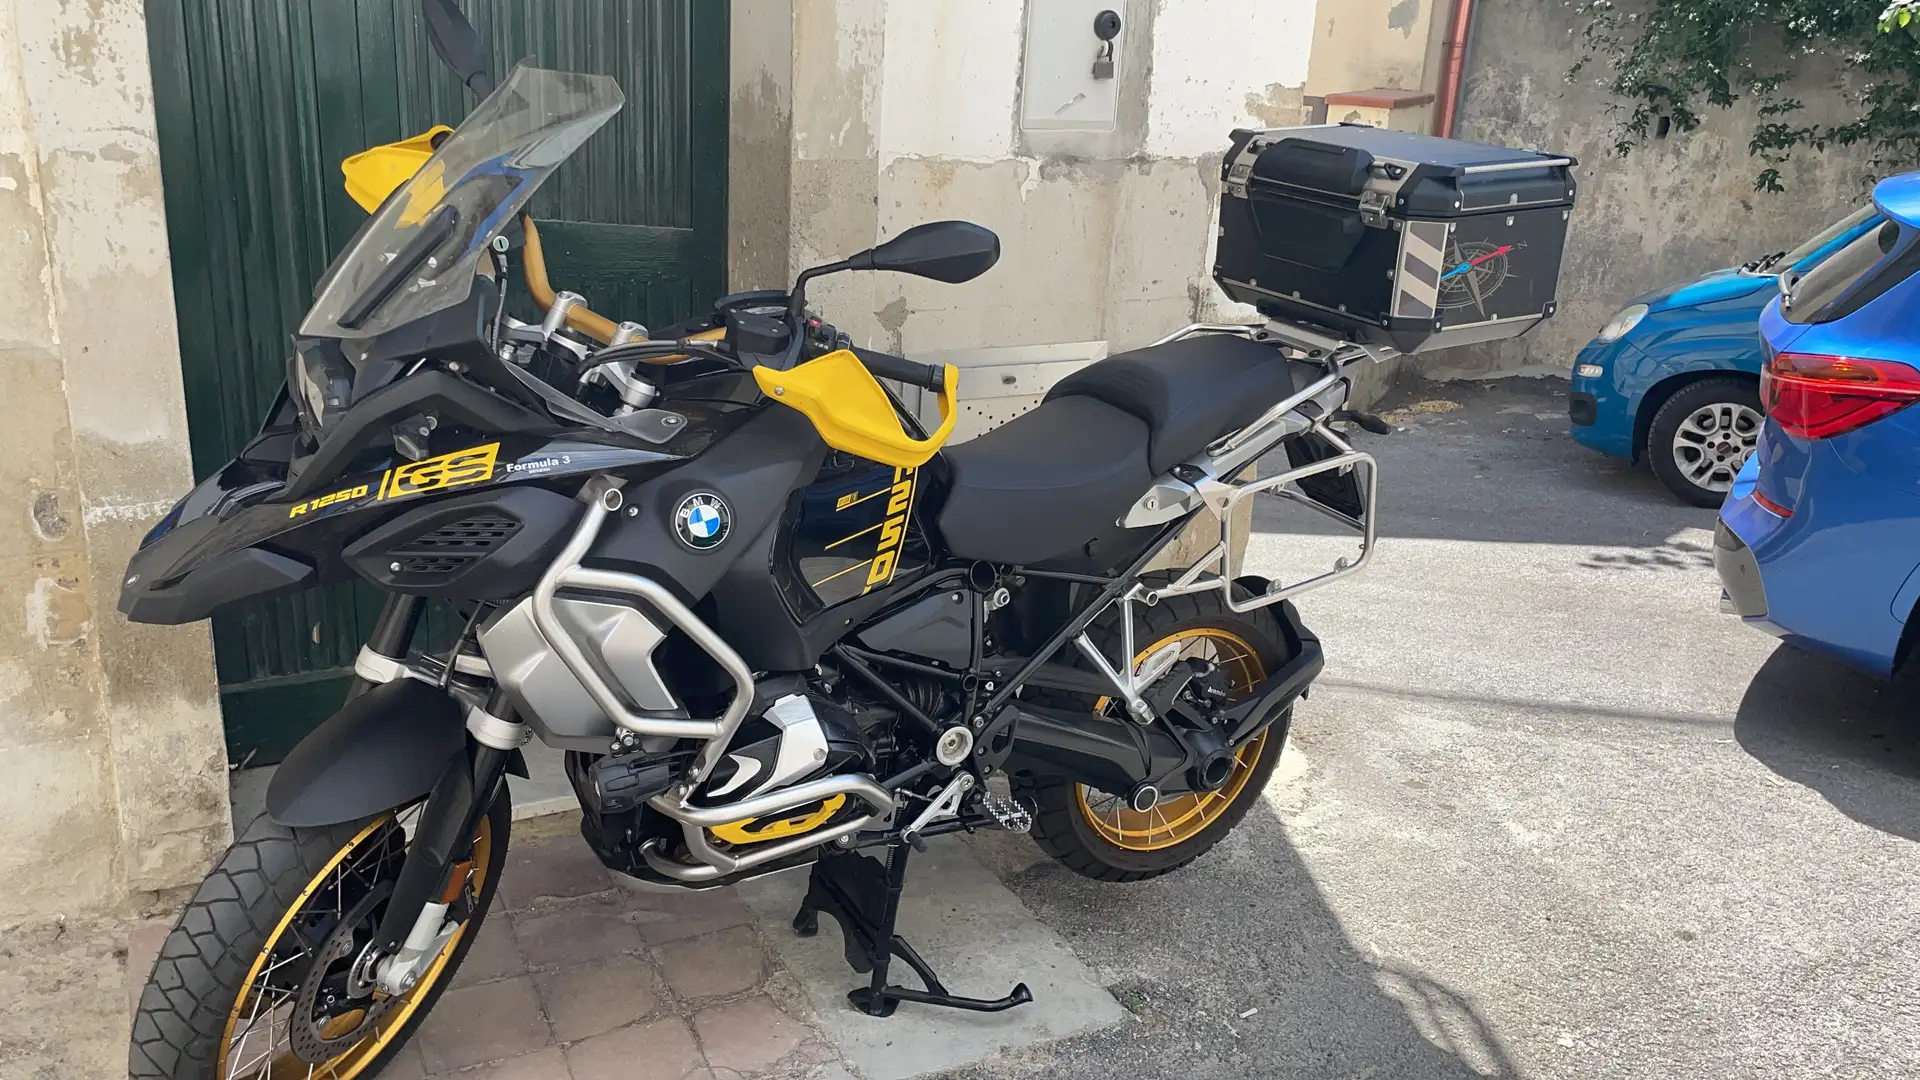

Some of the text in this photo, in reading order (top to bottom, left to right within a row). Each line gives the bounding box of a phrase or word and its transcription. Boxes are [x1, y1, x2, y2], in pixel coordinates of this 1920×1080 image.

[506, 457, 560, 473] Formula
[562, 455, 571, 465] 3
[288, 451, 493, 519] R 1250 GS
[679, 496, 722, 519] BMW
